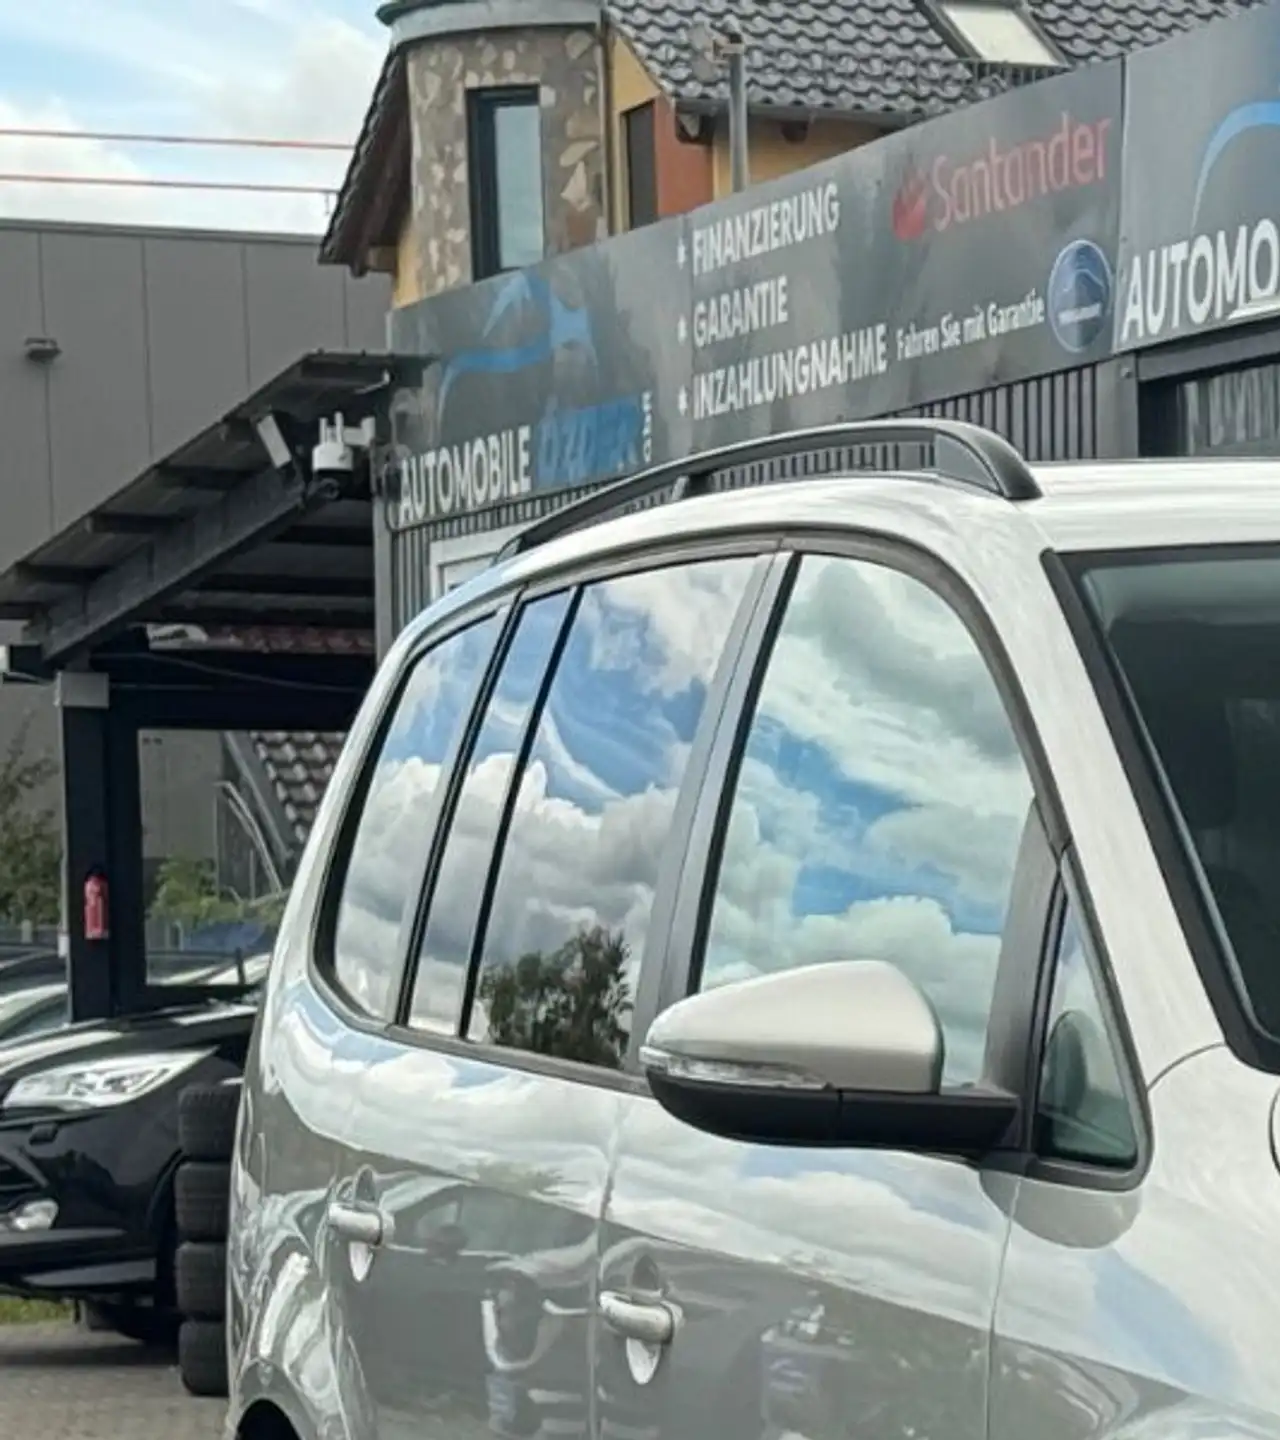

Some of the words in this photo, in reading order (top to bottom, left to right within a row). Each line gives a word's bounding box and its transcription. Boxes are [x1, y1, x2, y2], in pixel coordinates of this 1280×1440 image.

[932, 110, 1112, 232] Santander
[692, 183, 840, 277] FINANZIERUNG
[693, 275, 789, 348] GARANTIE
[693, 323, 888, 420] INZAHLUNGNAHME
[400, 425, 531, 523] AUTOMOBILE
